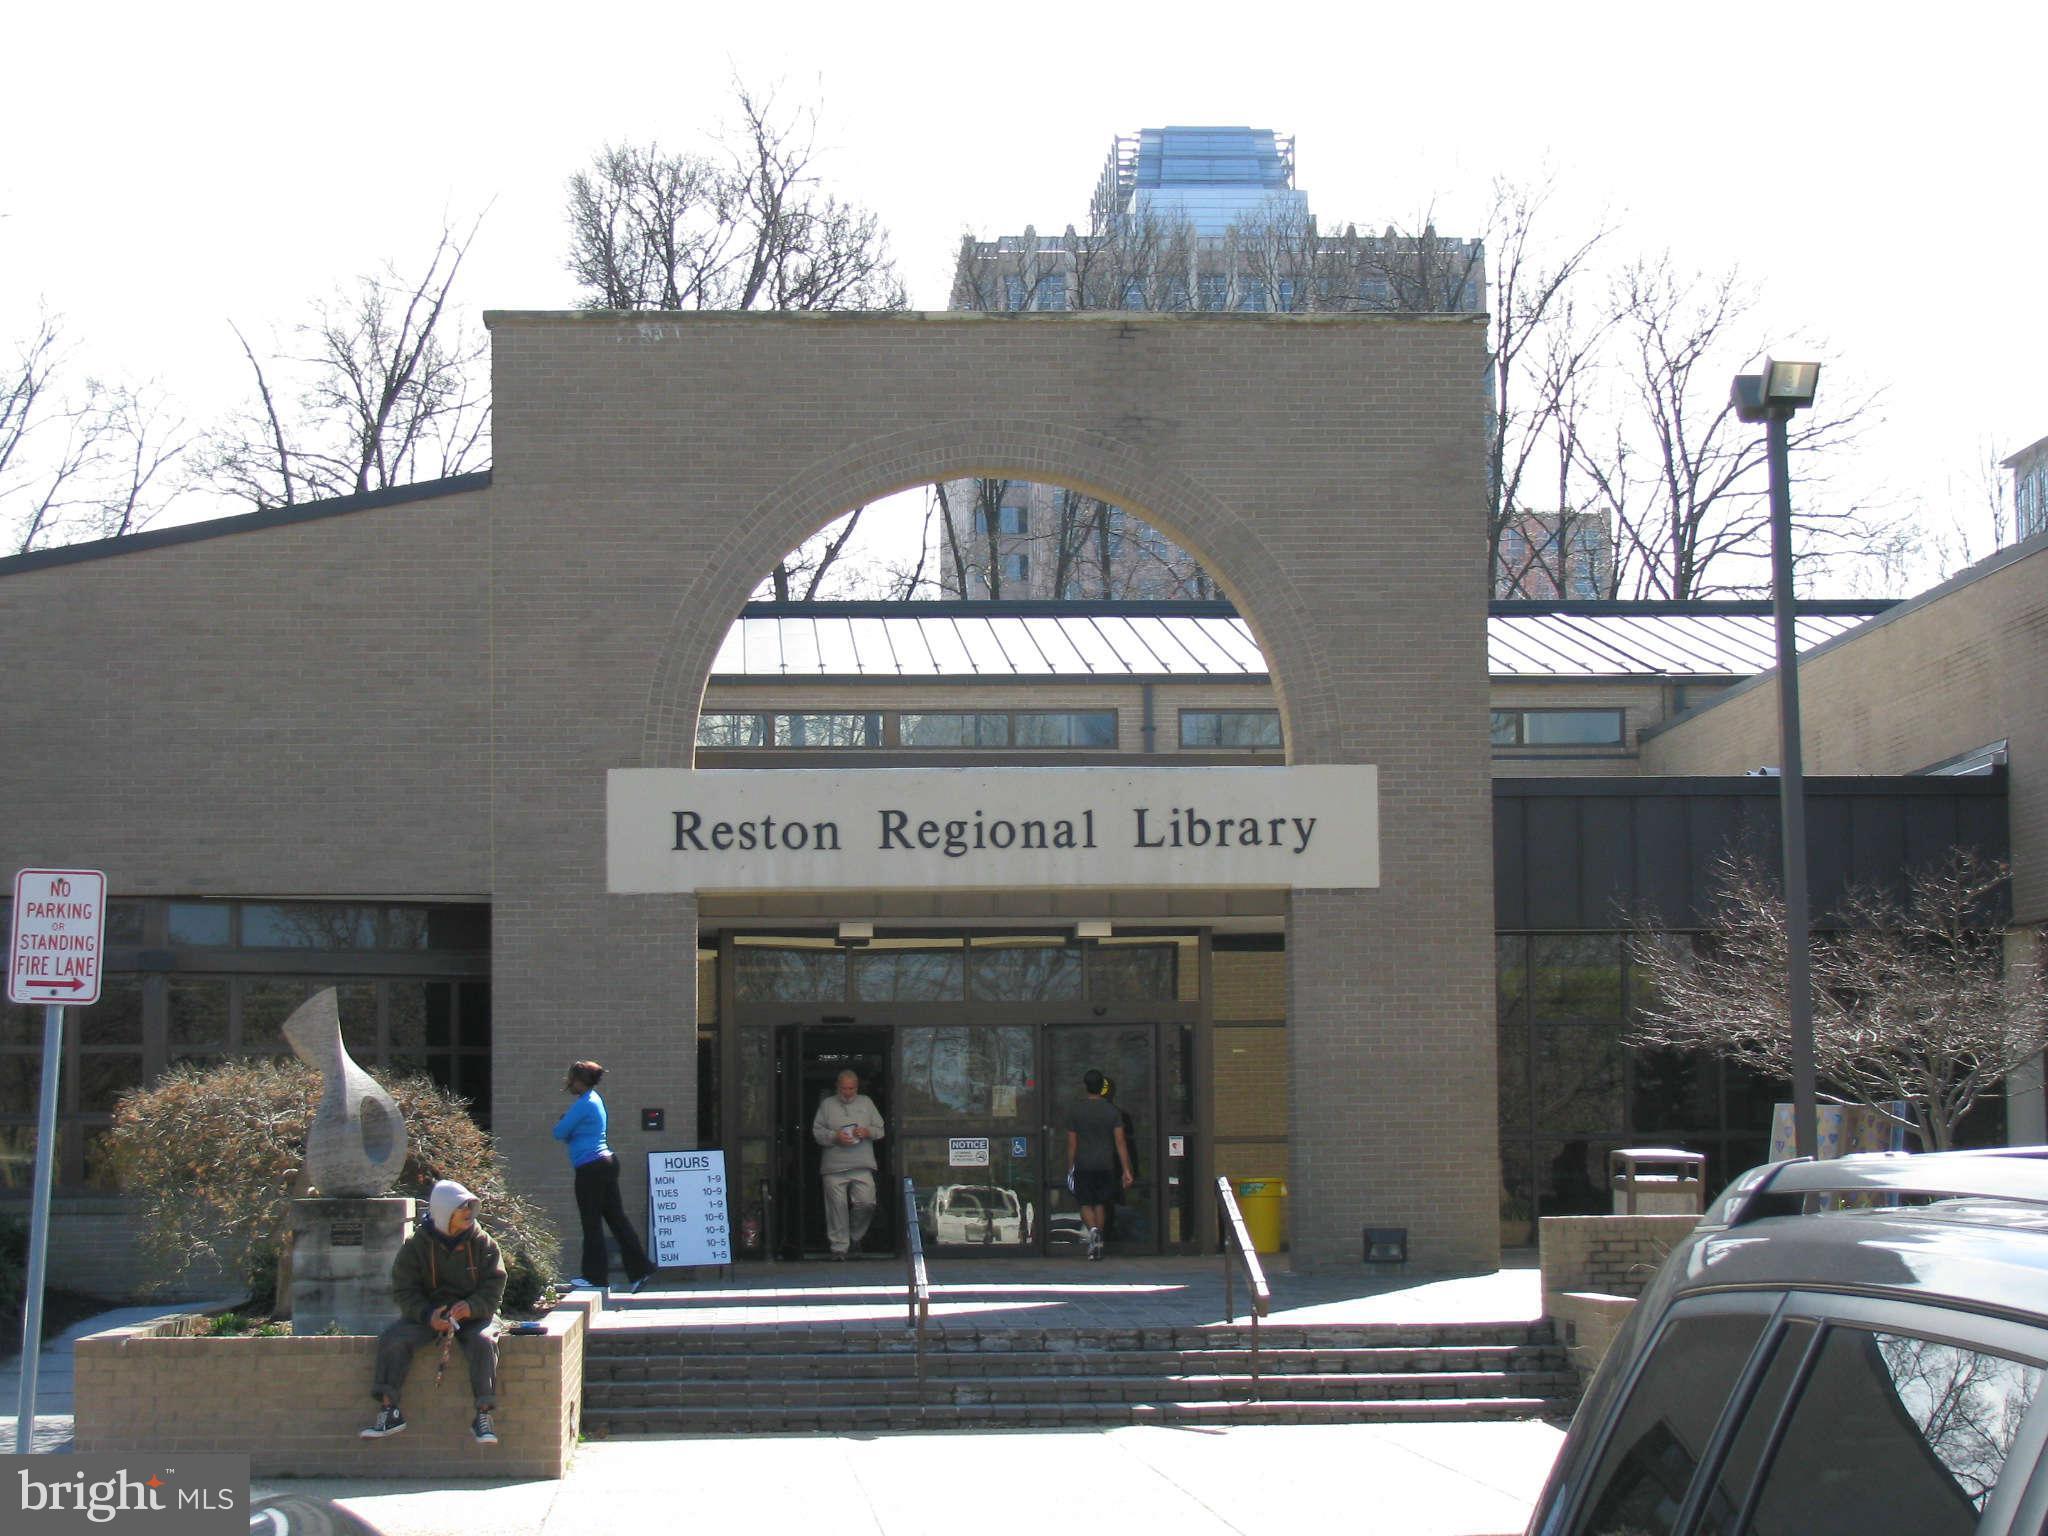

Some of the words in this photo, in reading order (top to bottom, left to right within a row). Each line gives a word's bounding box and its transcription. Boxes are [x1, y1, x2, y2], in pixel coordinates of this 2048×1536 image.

[671, 810, 843, 852] Reston
[879, 809, 1098, 858] Regional
[1133, 808, 1318, 854] Library
[50, 881, 71, 897] NO
[26, 902, 92, 919] PARKING
[52, 922, 65, 931] OR
[20, 934, 95, 951] STANDING
[17, 956, 50, 976] FIRE
[56, 957, 95, 977] LANE
[665, 1156, 710, 1169] HOURS
[655, 1176, 675, 1185] MON
[707, 1174, 722, 1183] 1-9
[656, 1189, 679, 1198] TUES
[703, 1187, 722, 1196] 10-9
[657, 1202, 677, 1210] WED
[709, 1200, 723, 1208] 1-9
[659, 1214, 687, 1223] THURS
[659, 1228, 672, 1236] FRI
[660, 1240, 675, 1249] SAT
[661, 1253, 679, 1261] SUN
